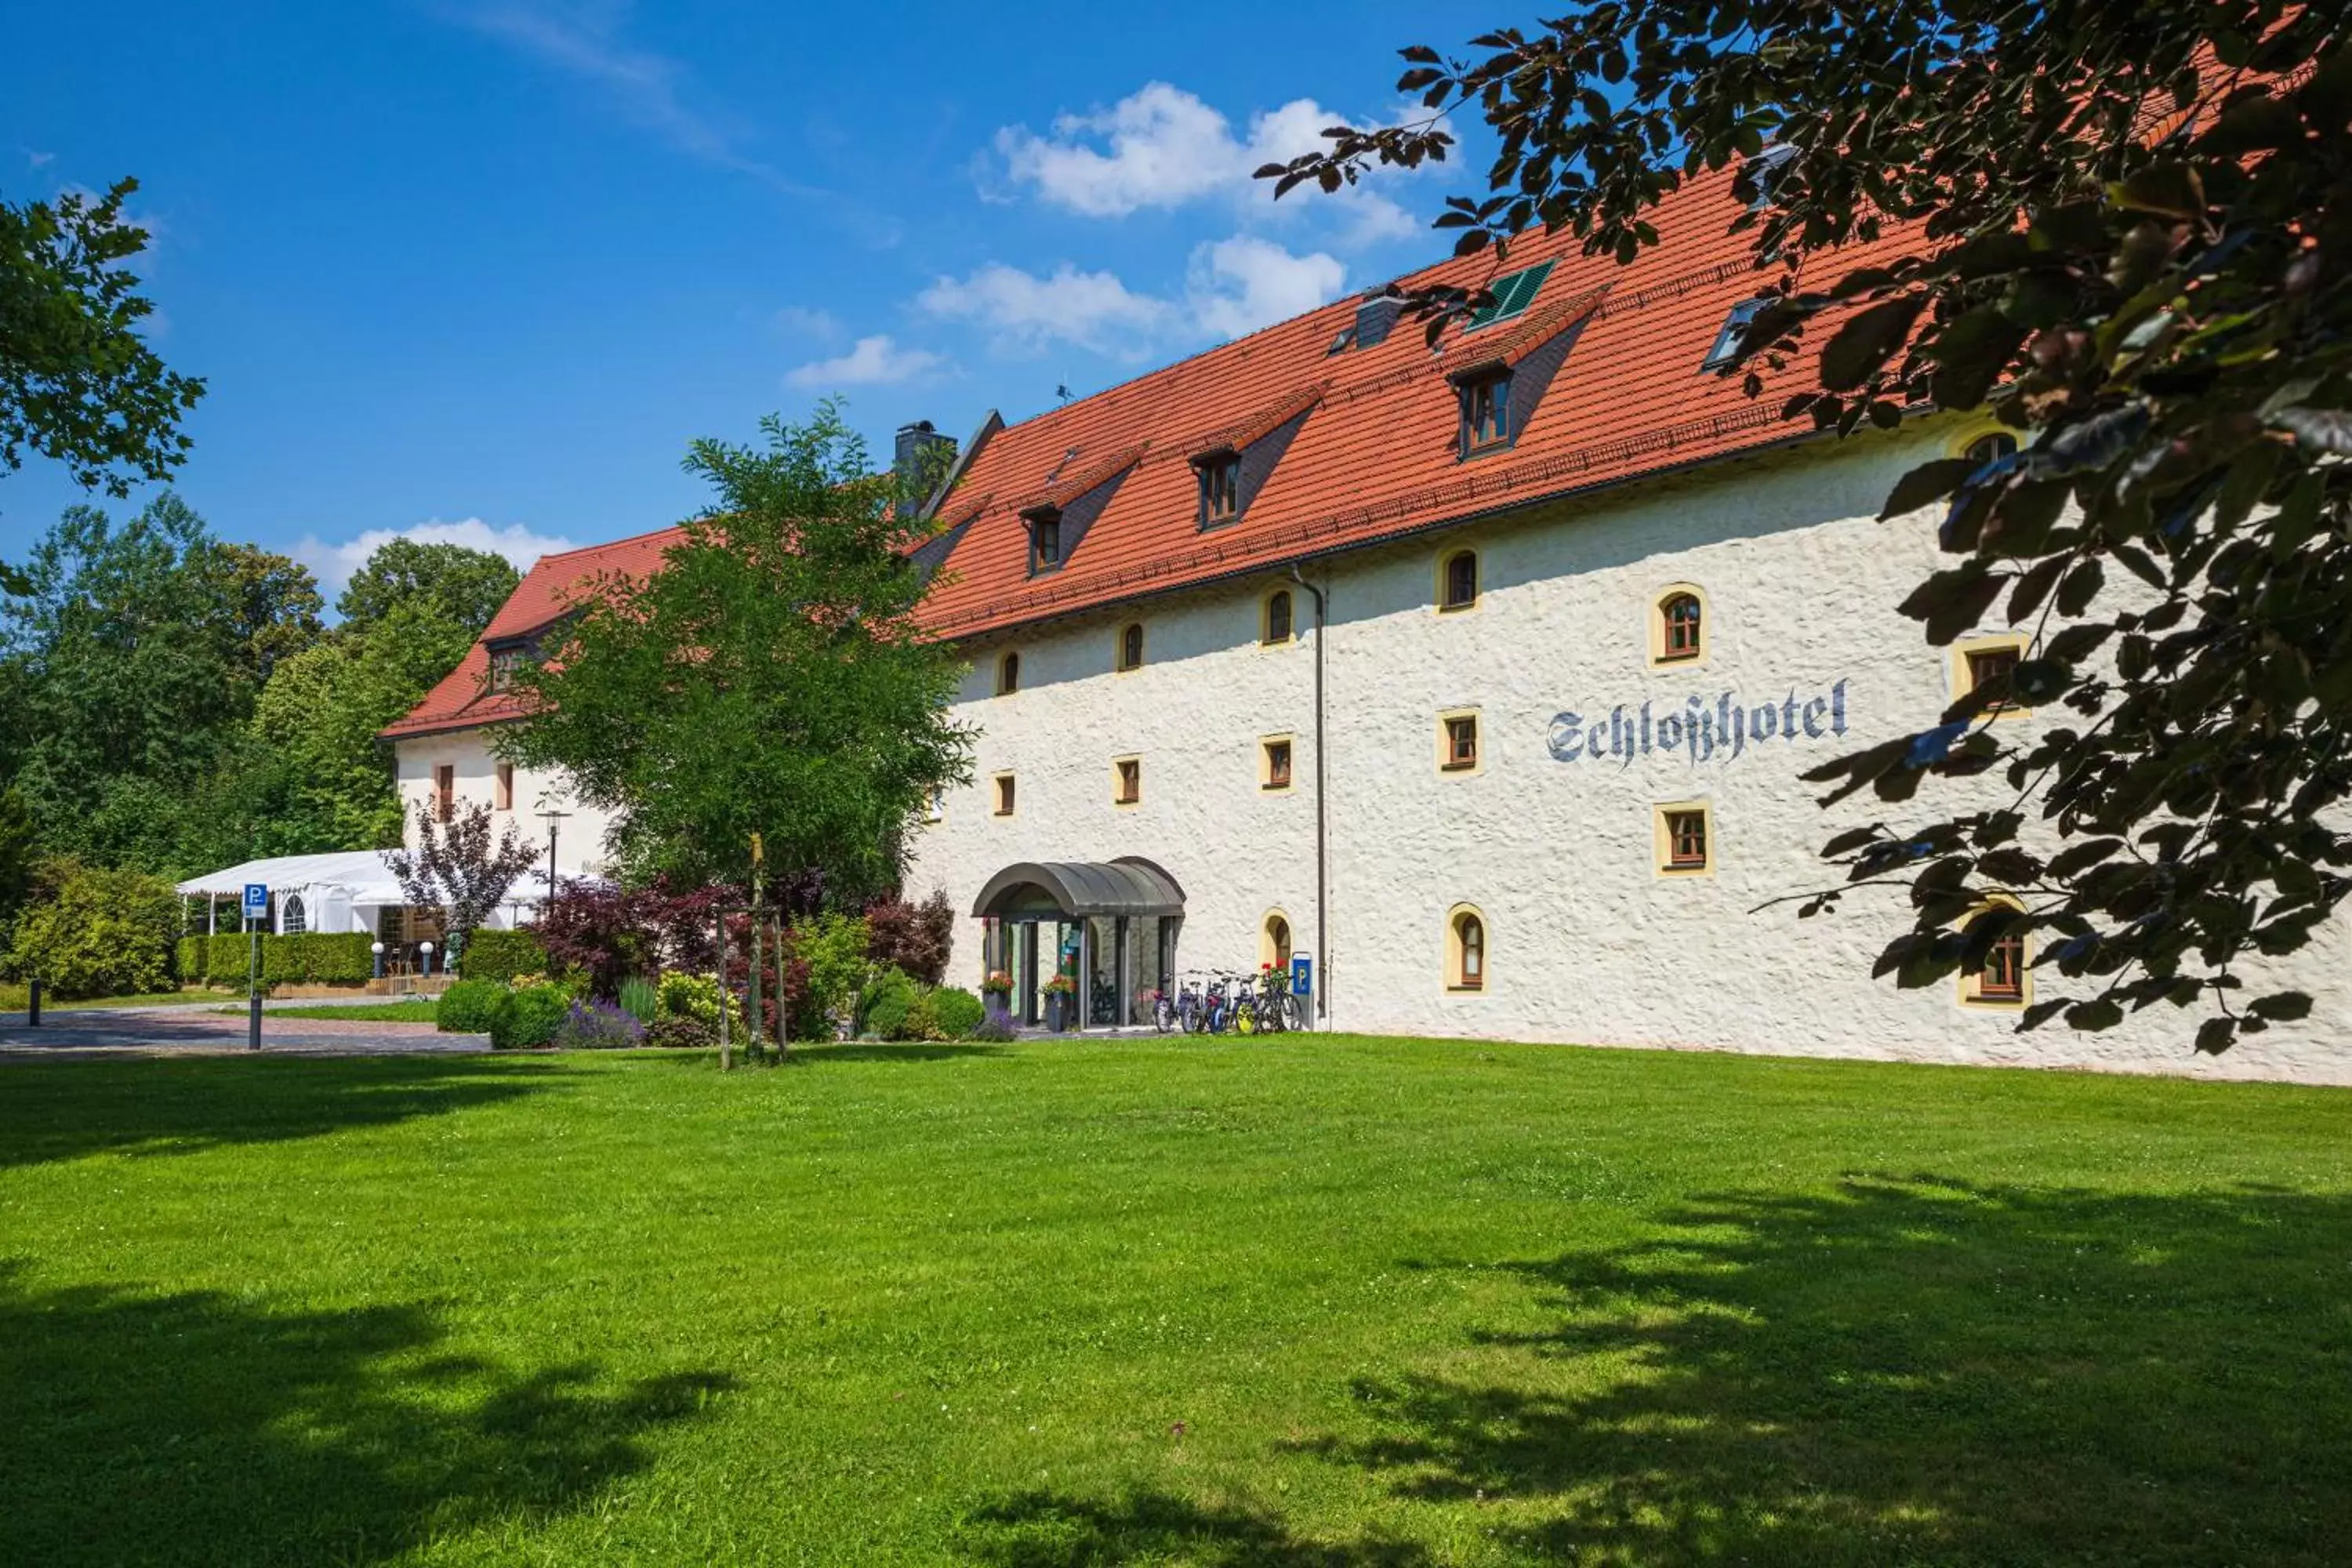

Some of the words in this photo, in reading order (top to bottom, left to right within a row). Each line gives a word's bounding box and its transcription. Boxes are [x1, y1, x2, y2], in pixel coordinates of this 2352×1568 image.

[1547, 677, 1851, 773] Schloßhotel
[249, 887, 262, 903] P
[1298, 968, 1306, 985] P
